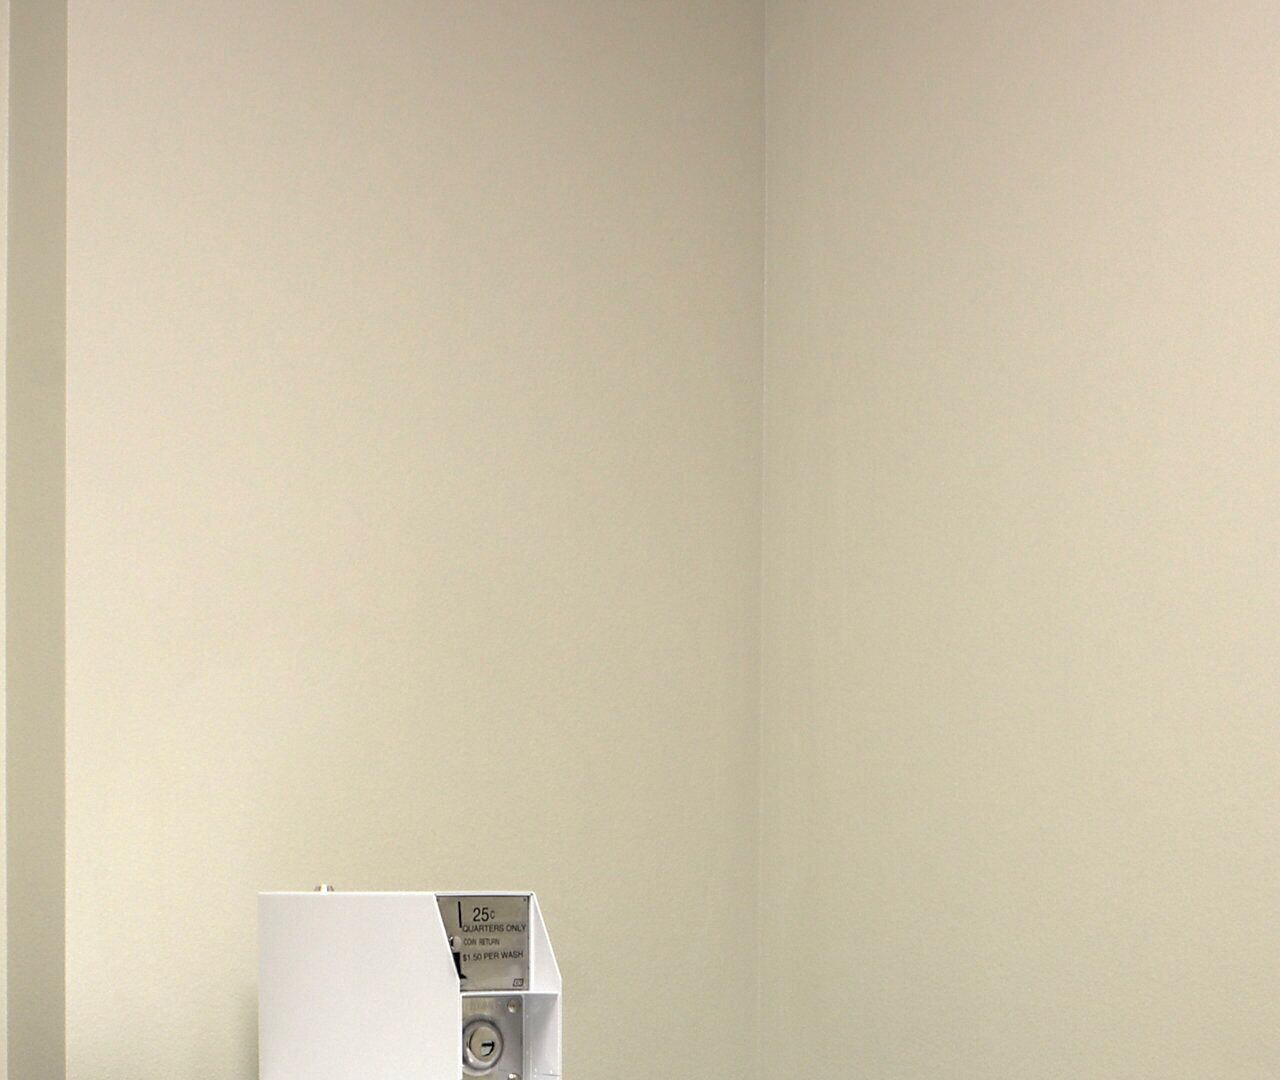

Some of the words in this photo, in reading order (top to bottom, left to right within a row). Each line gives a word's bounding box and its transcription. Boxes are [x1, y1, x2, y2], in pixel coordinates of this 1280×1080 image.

[506, 924, 526, 932] ONLY
[463, 954, 482, 962] $1.50
[484, 952, 499, 960] PER
[501, 951, 523, 959] WASH
